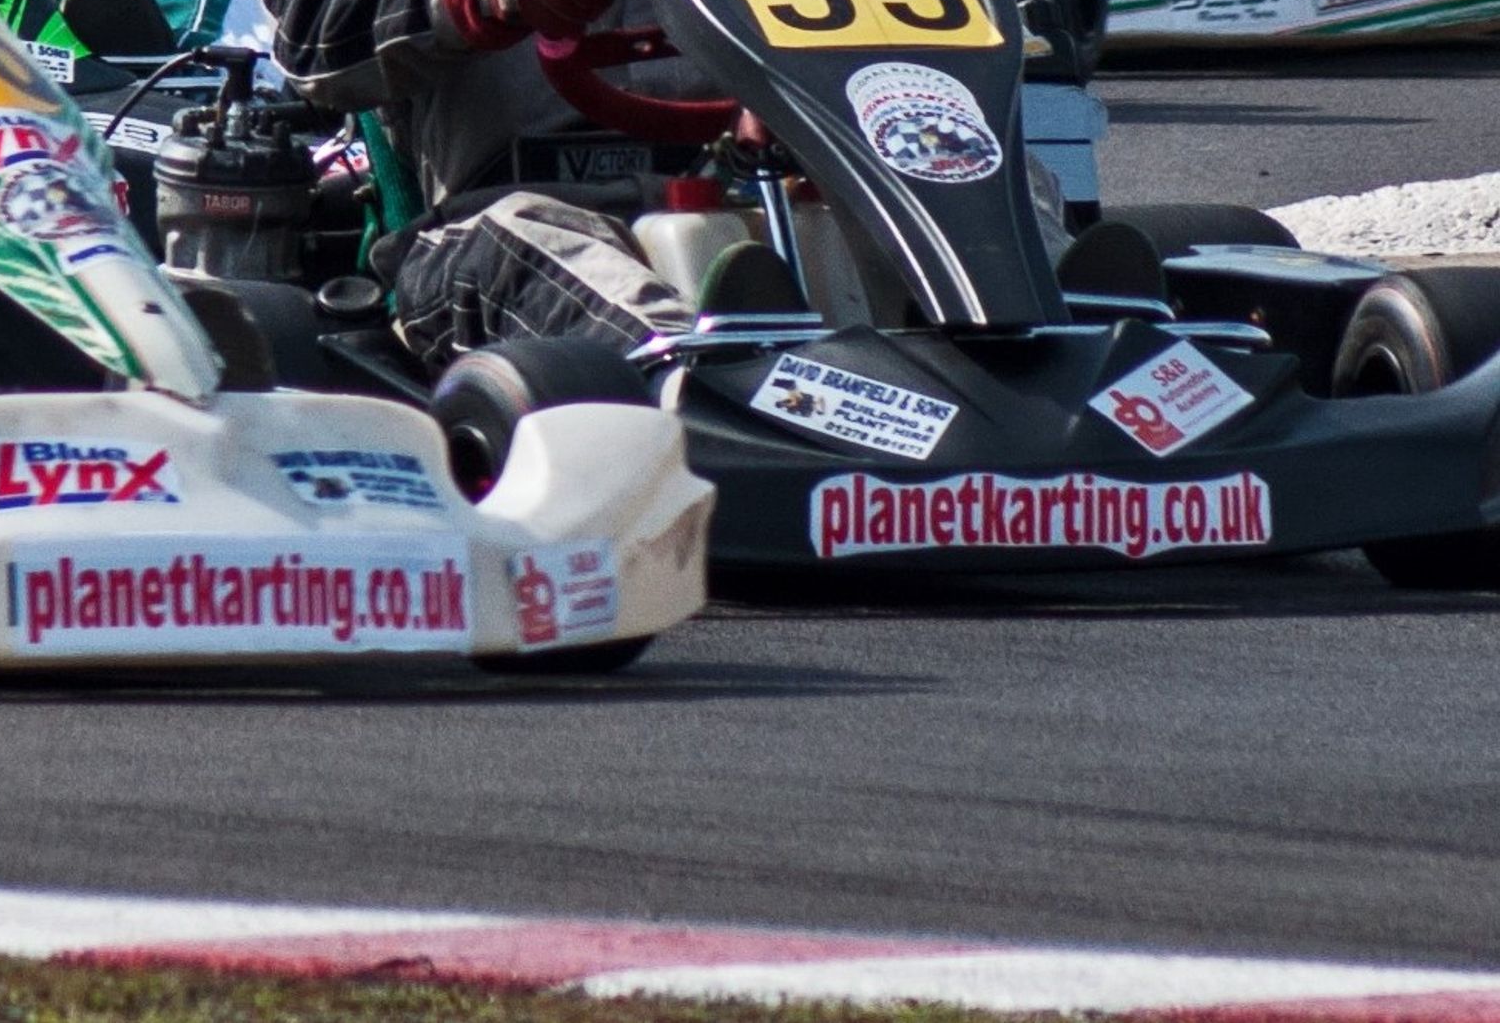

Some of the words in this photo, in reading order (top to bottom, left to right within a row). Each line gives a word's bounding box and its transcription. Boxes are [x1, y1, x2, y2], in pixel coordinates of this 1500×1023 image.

[20, 442, 129, 463] Blue
[820, 472, 1265, 558] planetkarting.co.uk
[25, 555, 467, 644] planetkarting.co.uk
